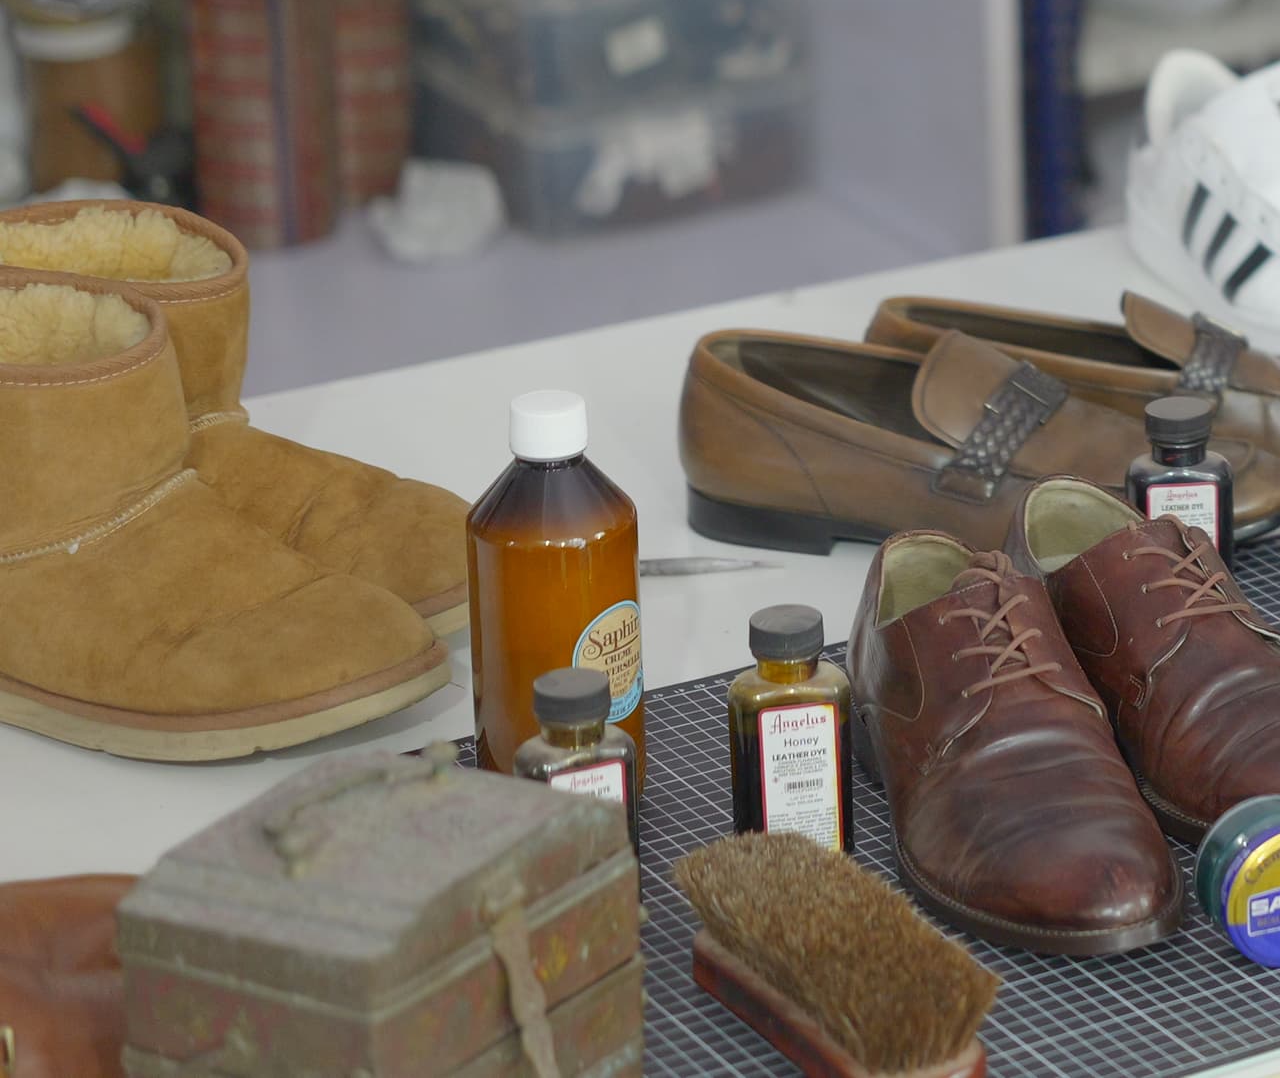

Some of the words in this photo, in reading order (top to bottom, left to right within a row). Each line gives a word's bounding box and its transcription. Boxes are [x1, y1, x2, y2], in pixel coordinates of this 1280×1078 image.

[1161, 504, 1190, 512] LEATHER
[769, 712, 827, 735] Angelus
[784, 736, 819, 748] Honey
[772, 751, 809, 762] LEATHER
[810, 748, 827, 757] DYE
